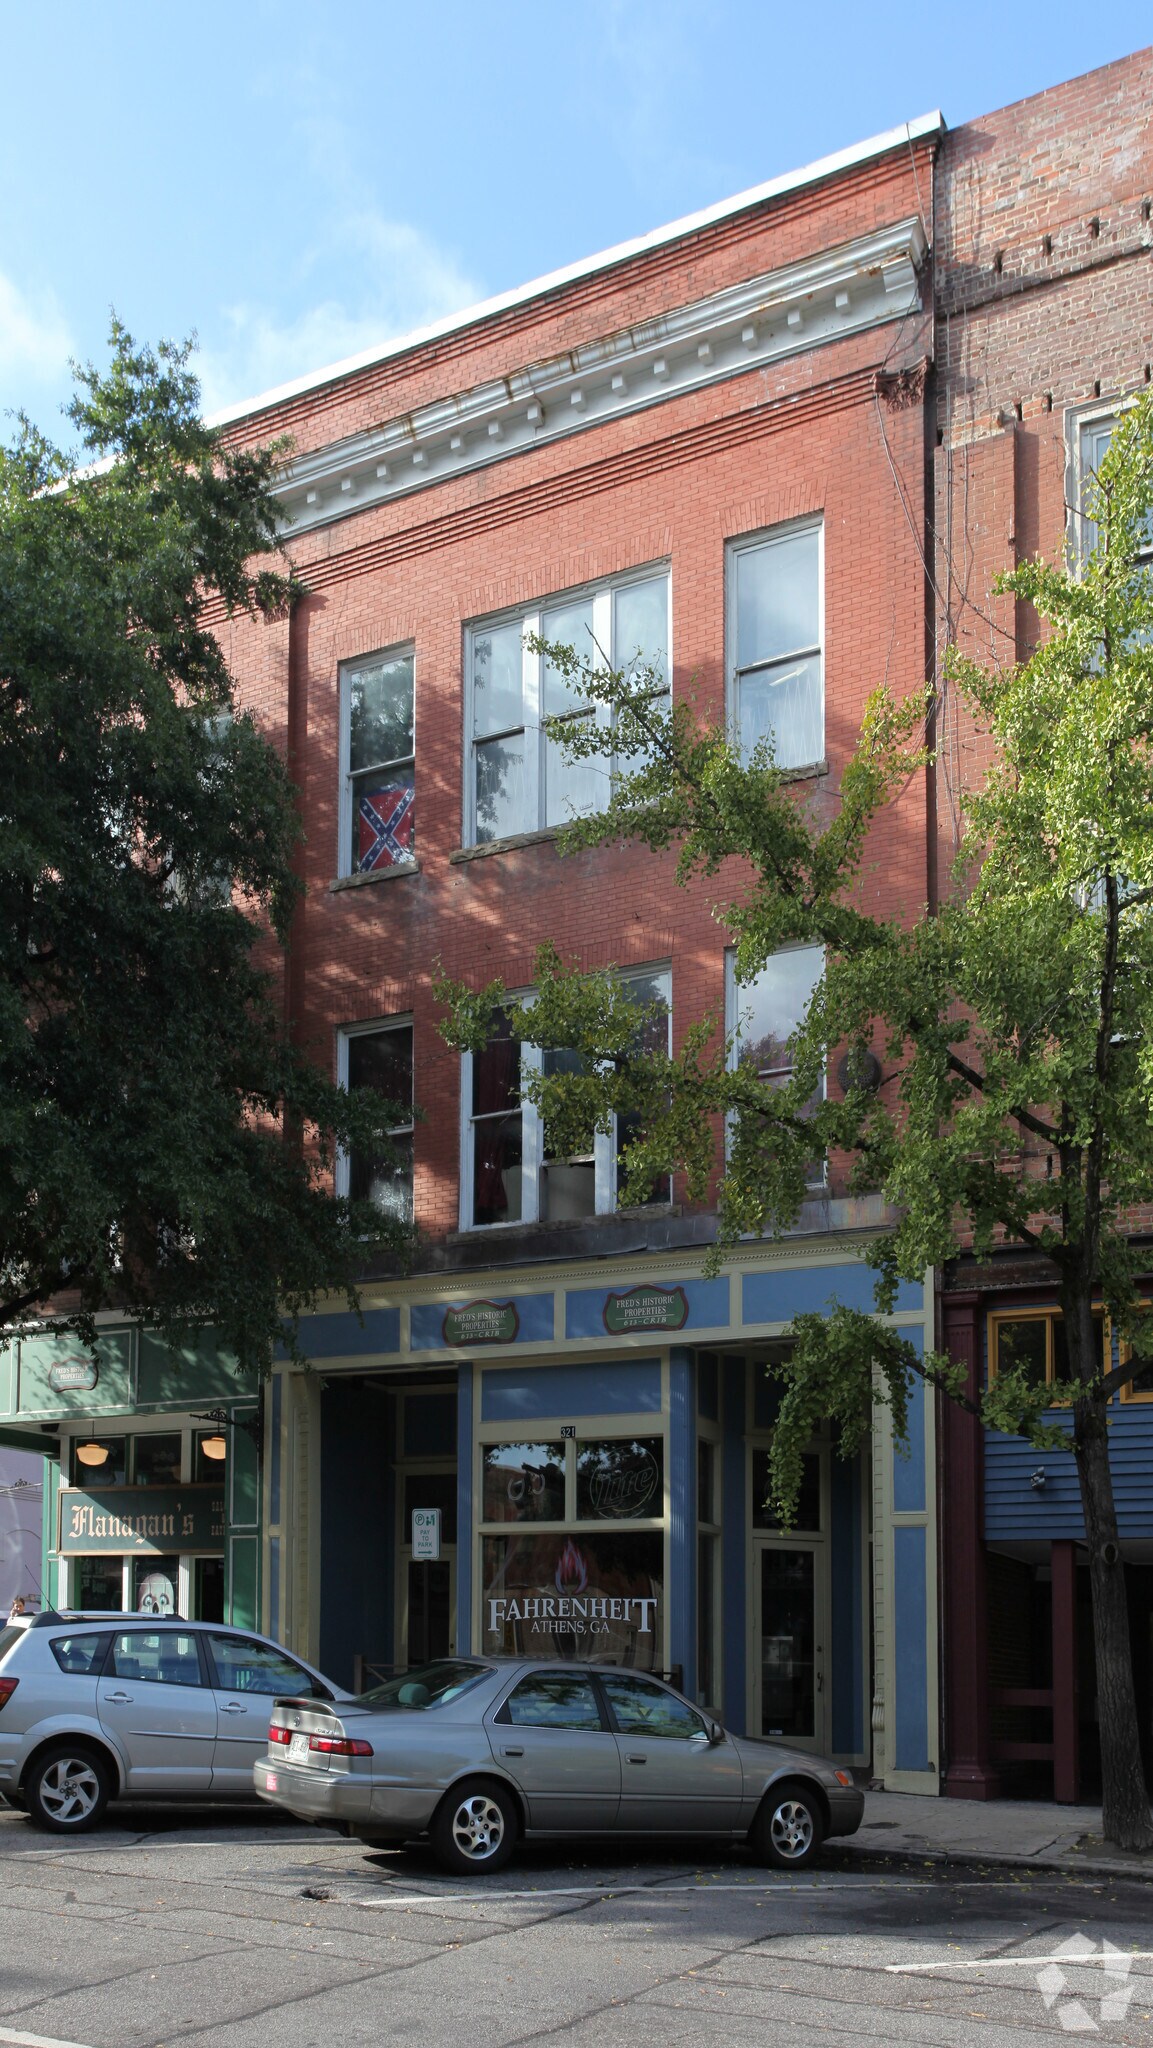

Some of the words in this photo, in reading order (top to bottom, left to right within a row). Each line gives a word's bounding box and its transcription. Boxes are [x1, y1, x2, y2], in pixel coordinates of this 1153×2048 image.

[616, 1299, 640, 1308] FRED'S
[642, 1296, 674, 1306] HISTORIC
[454, 1313, 476, 1322] FRED'S
[477, 1310, 507, 1320] HISTORIC
[624, 1306, 667, 1317] PROPERTIES
[461, 1320, 500, 1330] PROPERTIES
[561, 1427, 575, 1438] 321
[68, 1502, 194, 1544] Flanagan's
[487, 1598, 657, 1633] FAHRENHEIT
[530, 1620, 588, 1635] ATHENS,
[589, 1621, 610, 1634] GA
